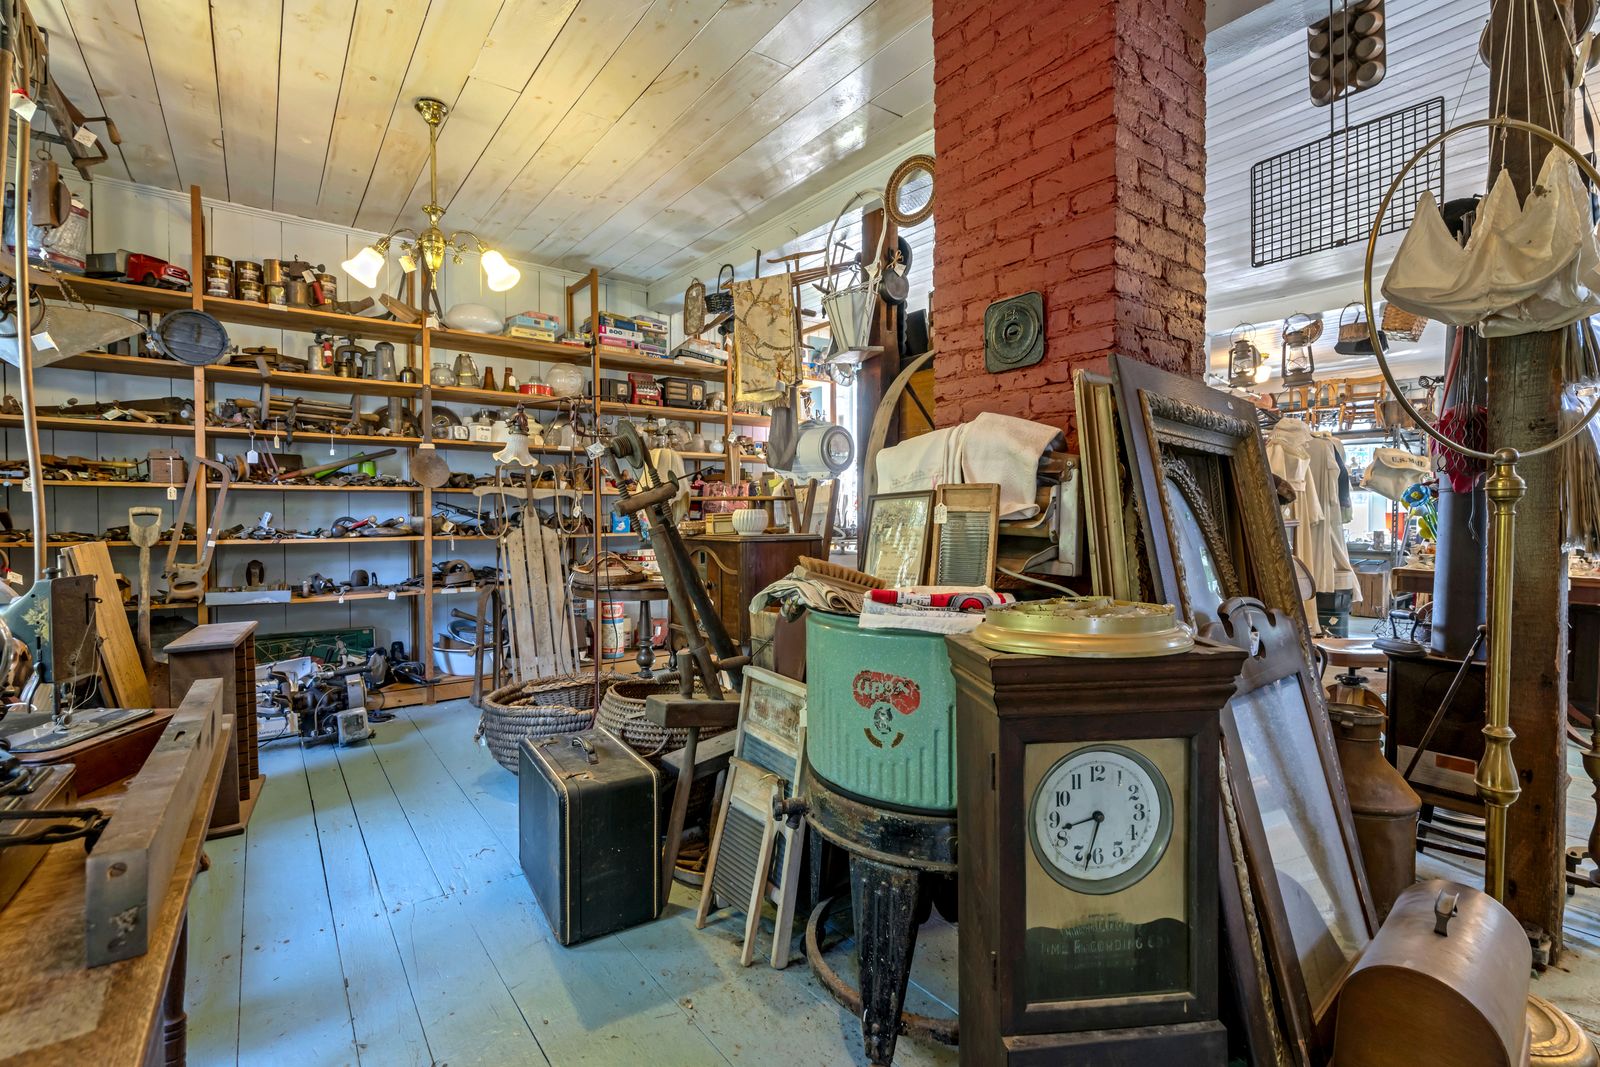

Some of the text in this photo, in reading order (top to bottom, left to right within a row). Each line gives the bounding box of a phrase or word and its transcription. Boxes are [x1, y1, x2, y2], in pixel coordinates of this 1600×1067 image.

[1071, 773, 1081, 790] 11
[1090, 765, 1105, 782] 12
[1117, 770, 1123, 787] 1
[1055, 790, 1071, 807] 10
[1128, 785, 1139, 801] 2
[1049, 811, 1060, 829] 9
[1133, 804, 1145, 821] 3
[1056, 830, 1068, 848] 8
[1127, 824, 1138, 841] 4
[1073, 845, 1084, 862] 7
[1092, 847, 1104, 865] 6
[1112, 841, 1124, 858] 5
